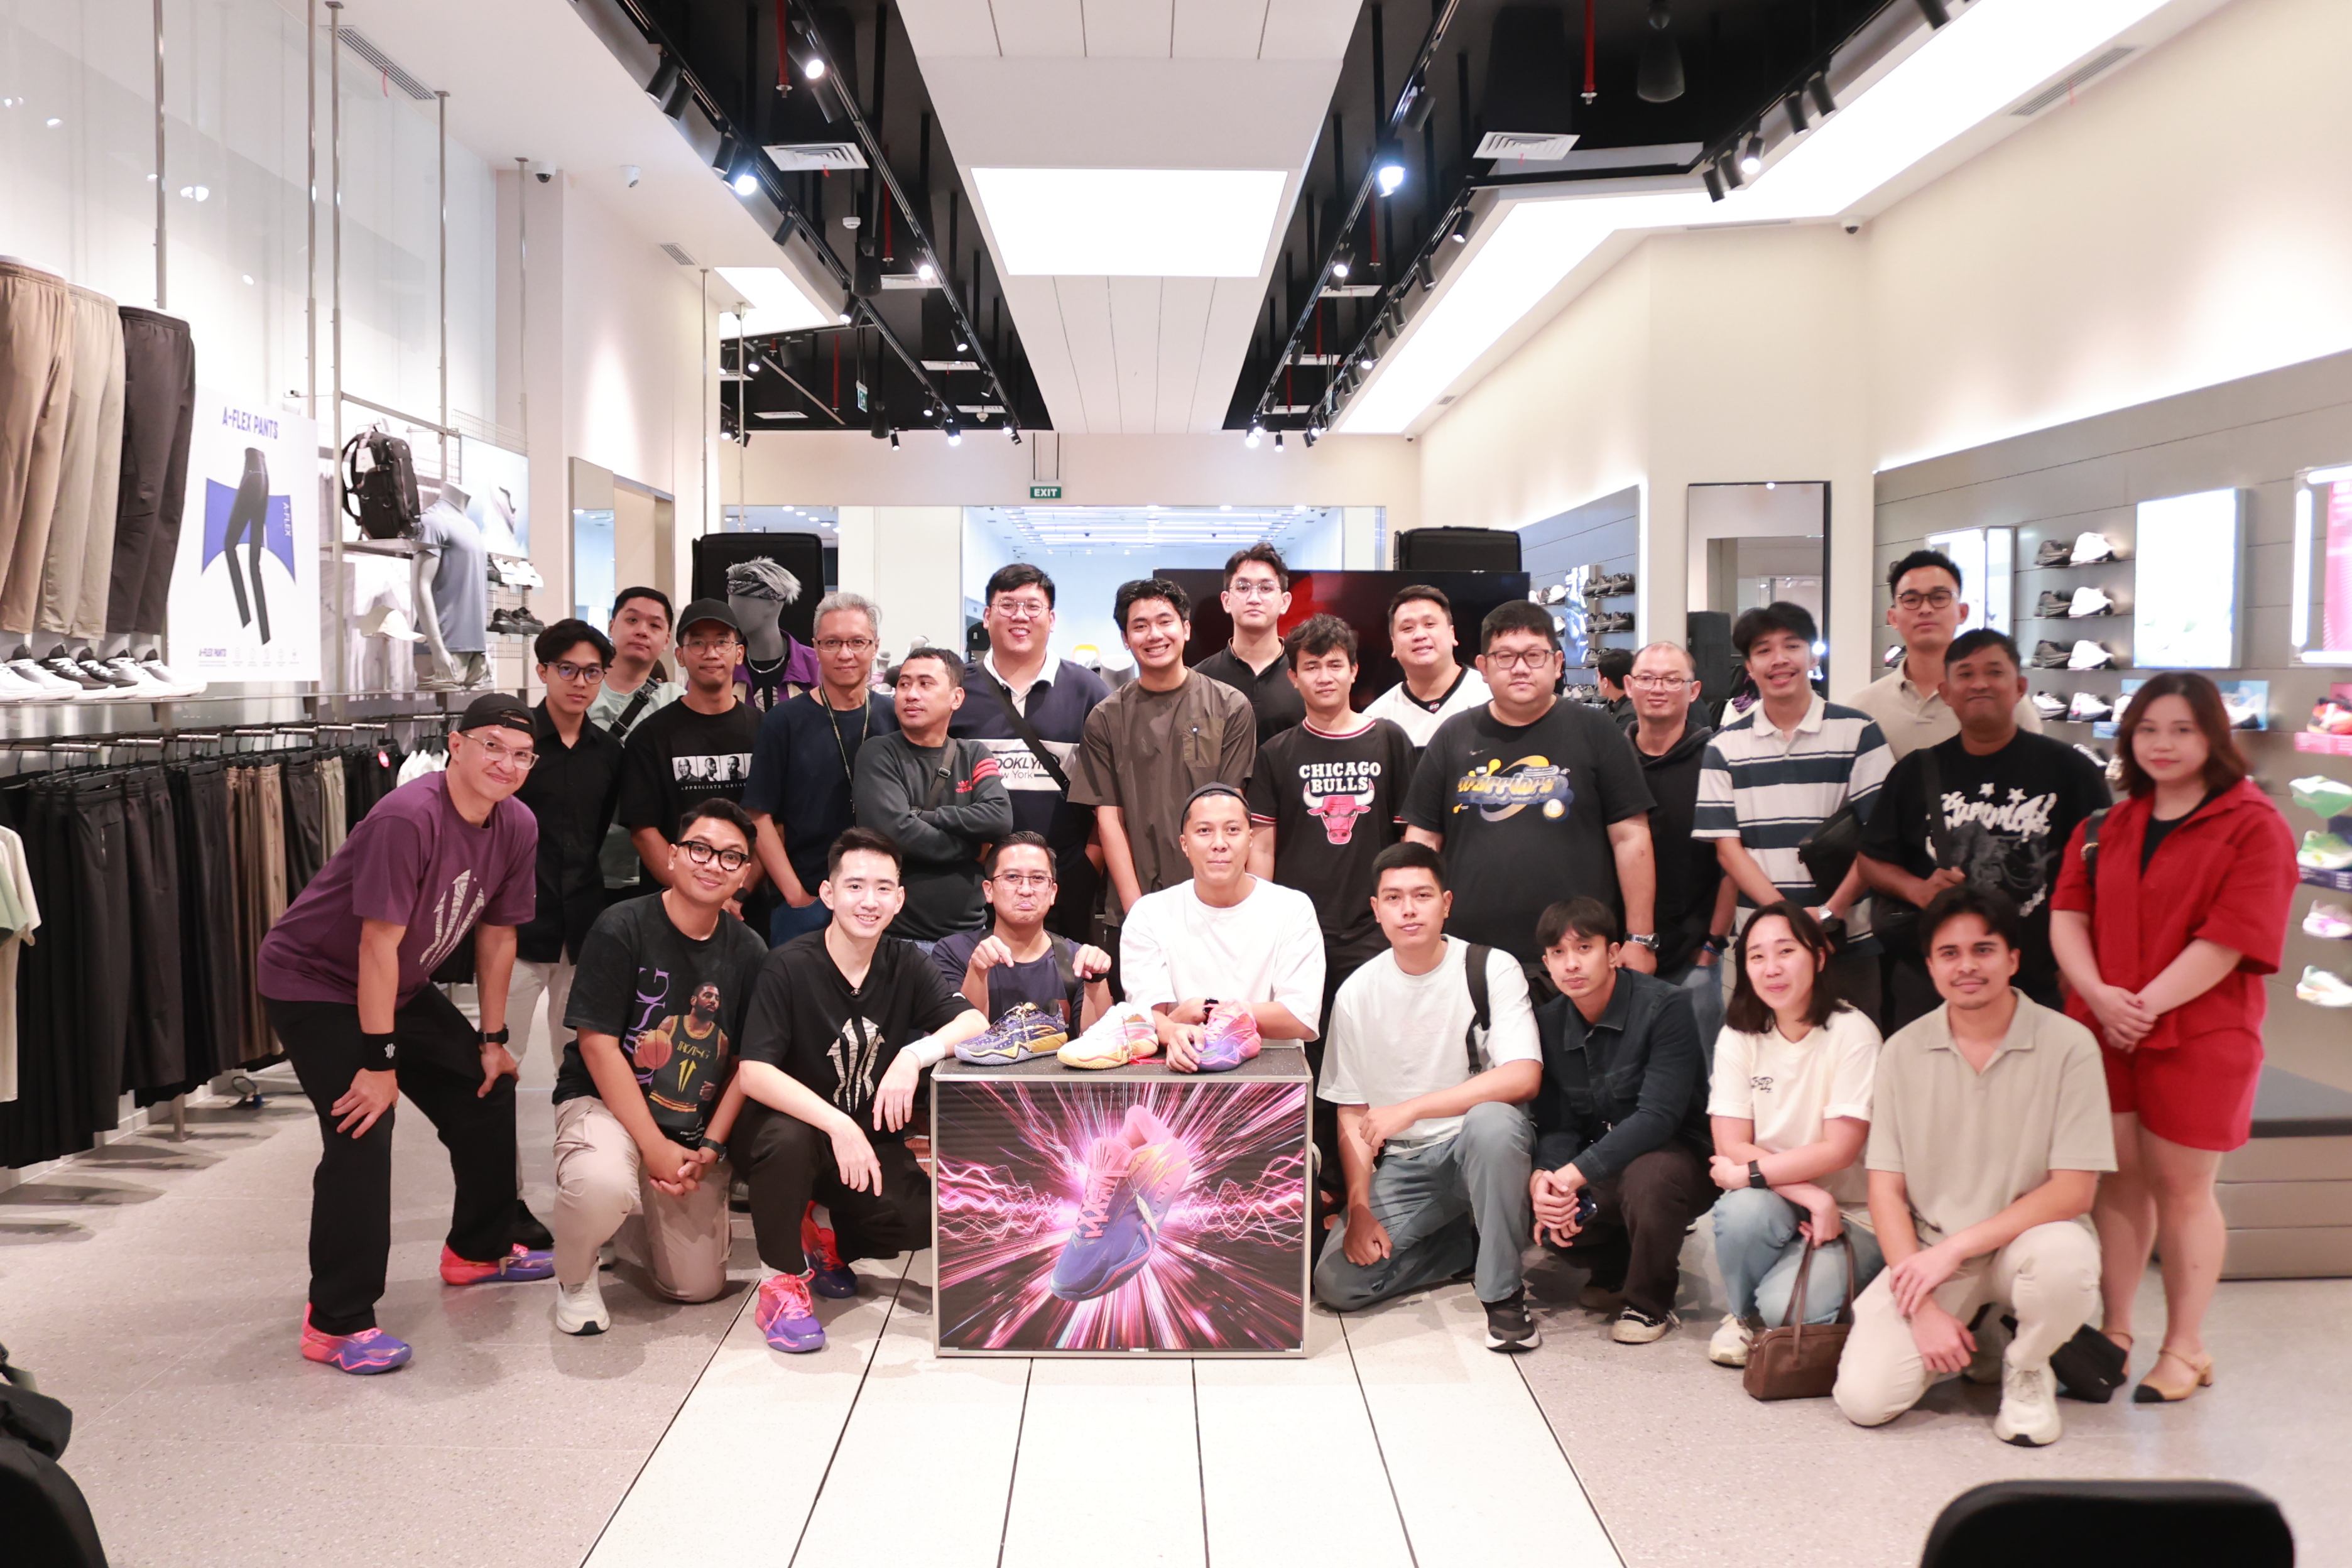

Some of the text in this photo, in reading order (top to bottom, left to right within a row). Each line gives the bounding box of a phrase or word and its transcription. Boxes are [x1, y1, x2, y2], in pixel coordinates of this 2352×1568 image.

[222, 406, 278, 440] A-FLEX PANTS
[1034, 488, 1057, 497] EXIT
[1012, 770, 1033, 779] York
[1298, 761, 1381, 779] CHICAGO
[1311, 776, 1369, 793] BULLS
